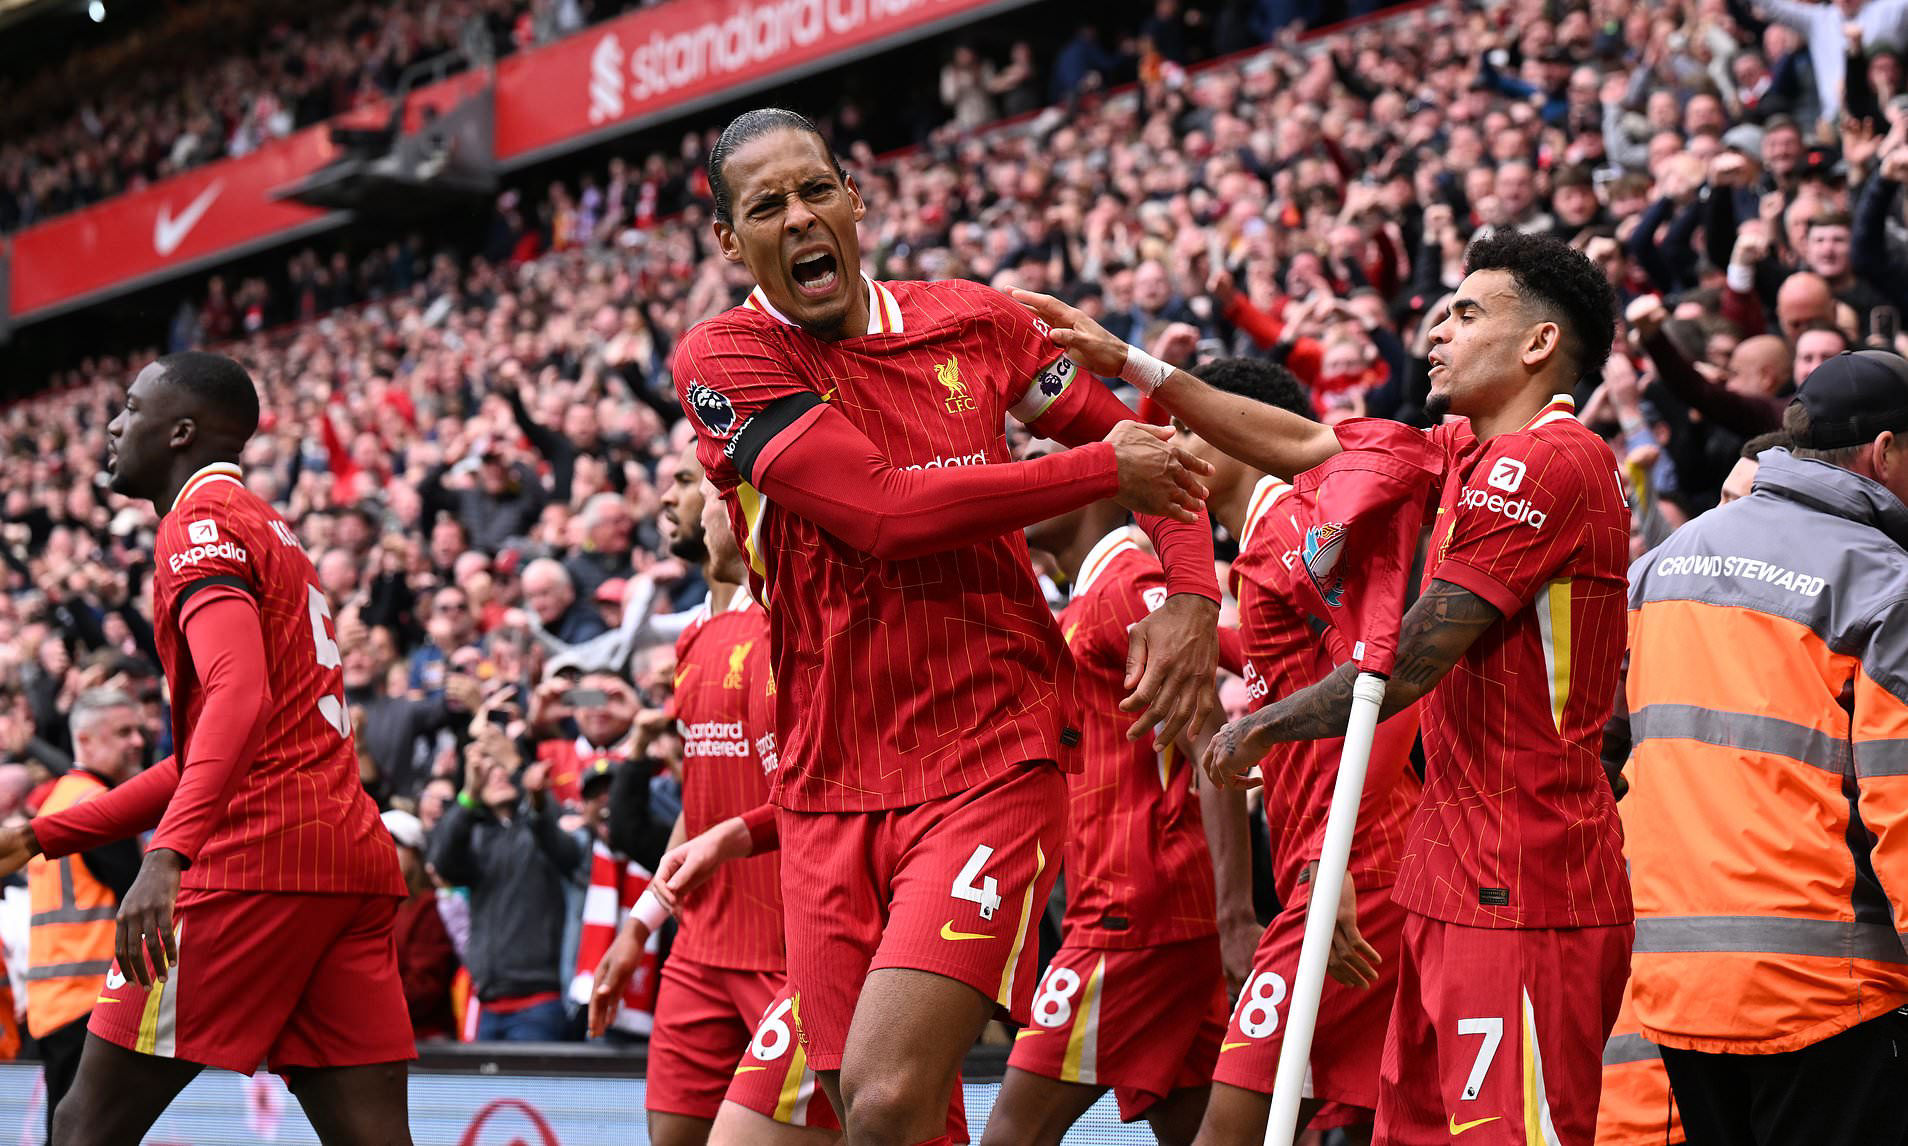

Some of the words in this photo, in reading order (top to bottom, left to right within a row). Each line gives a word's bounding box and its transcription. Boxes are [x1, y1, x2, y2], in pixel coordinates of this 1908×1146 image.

[168, 541, 247, 574] Expedia
[1657, 554, 1723, 578] CROWD
[1723, 555, 1826, 598] STEWARD
[307, 582, 351, 740] 5
[951, 844, 1002, 921] 4
[745, 997, 792, 1061] 6
[1030, 965, 1081, 1028] 8
[1229, 968, 1287, 1039] 8
[1457, 1017, 1504, 1101] 7
